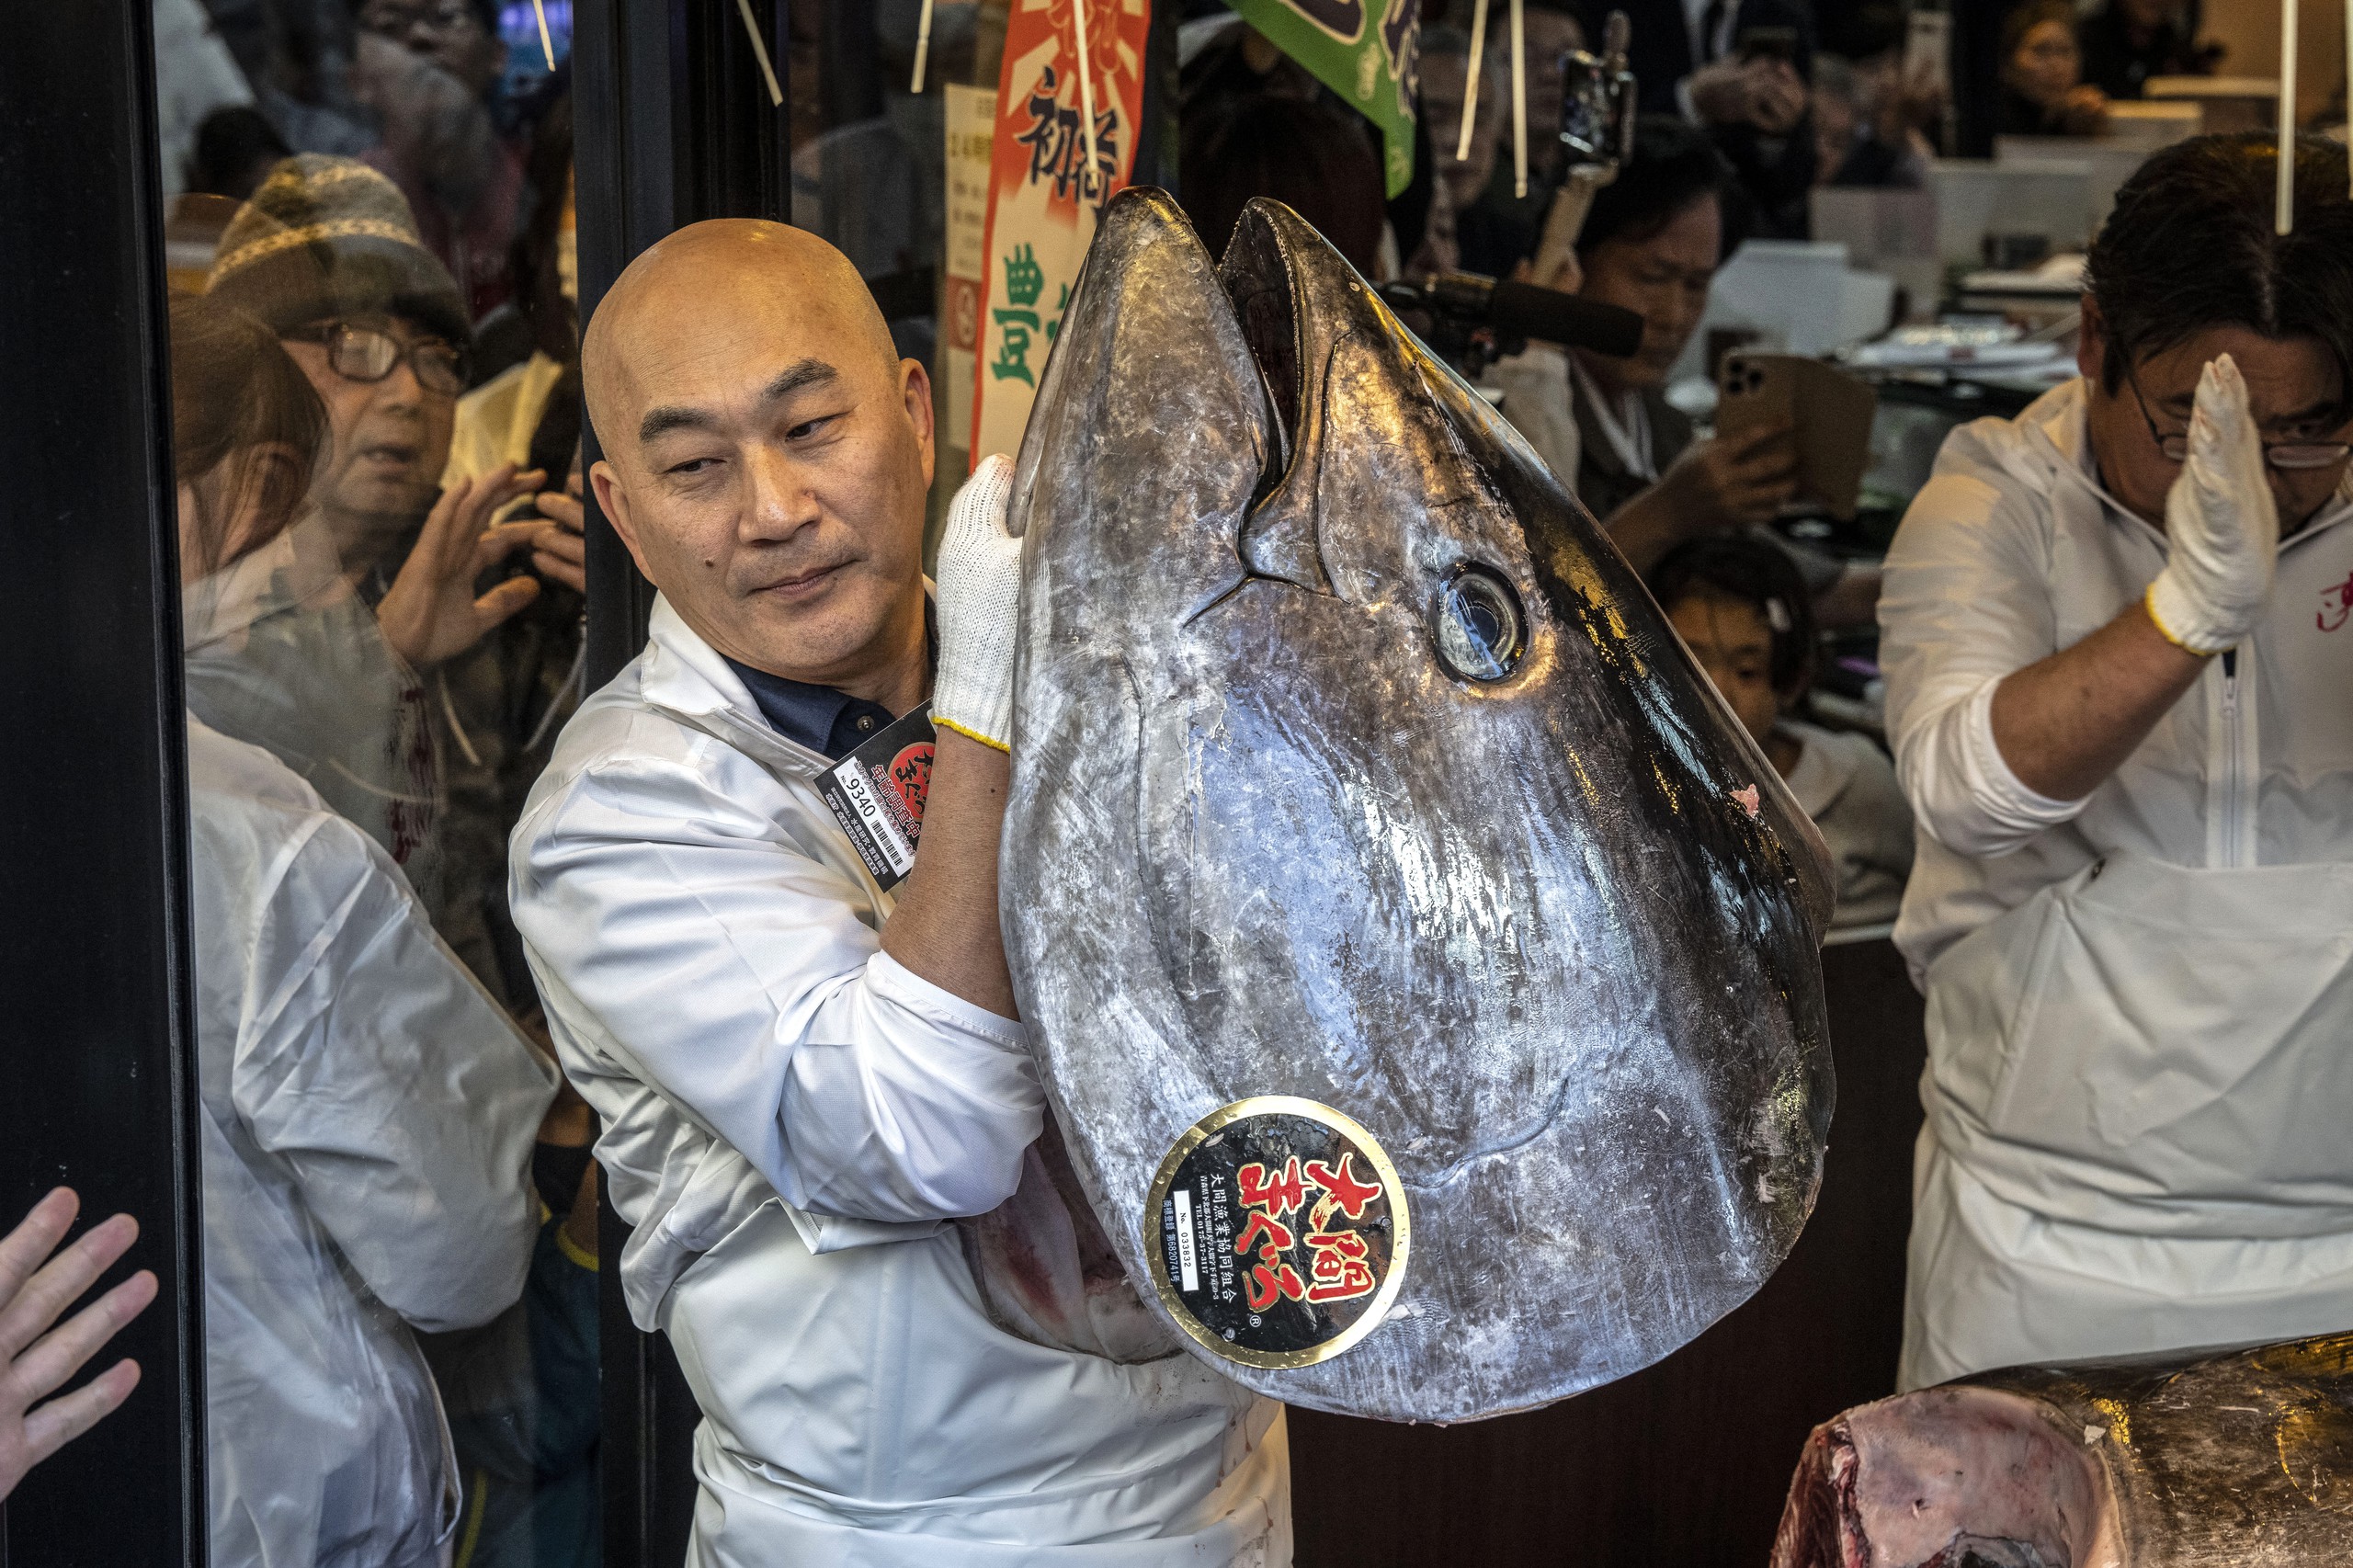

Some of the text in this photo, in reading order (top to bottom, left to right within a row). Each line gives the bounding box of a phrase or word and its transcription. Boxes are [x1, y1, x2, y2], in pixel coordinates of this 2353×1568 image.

[846, 778, 876, 817] 9340
[871, 764, 920, 838] 年齢調査中
[1163, 1199, 1181, 1283] 商標登録 第6820741号
[1179, 1212, 1192, 1267] No. 033832
[1195, 1204, 1209, 1274] TEL 0175-37-3117
[1210, 1173, 1237, 1303] 大間漁業協同組合
[1234, 1155, 1315, 1312] まぐろ
[1302, 1152, 1382, 1303] 大間
